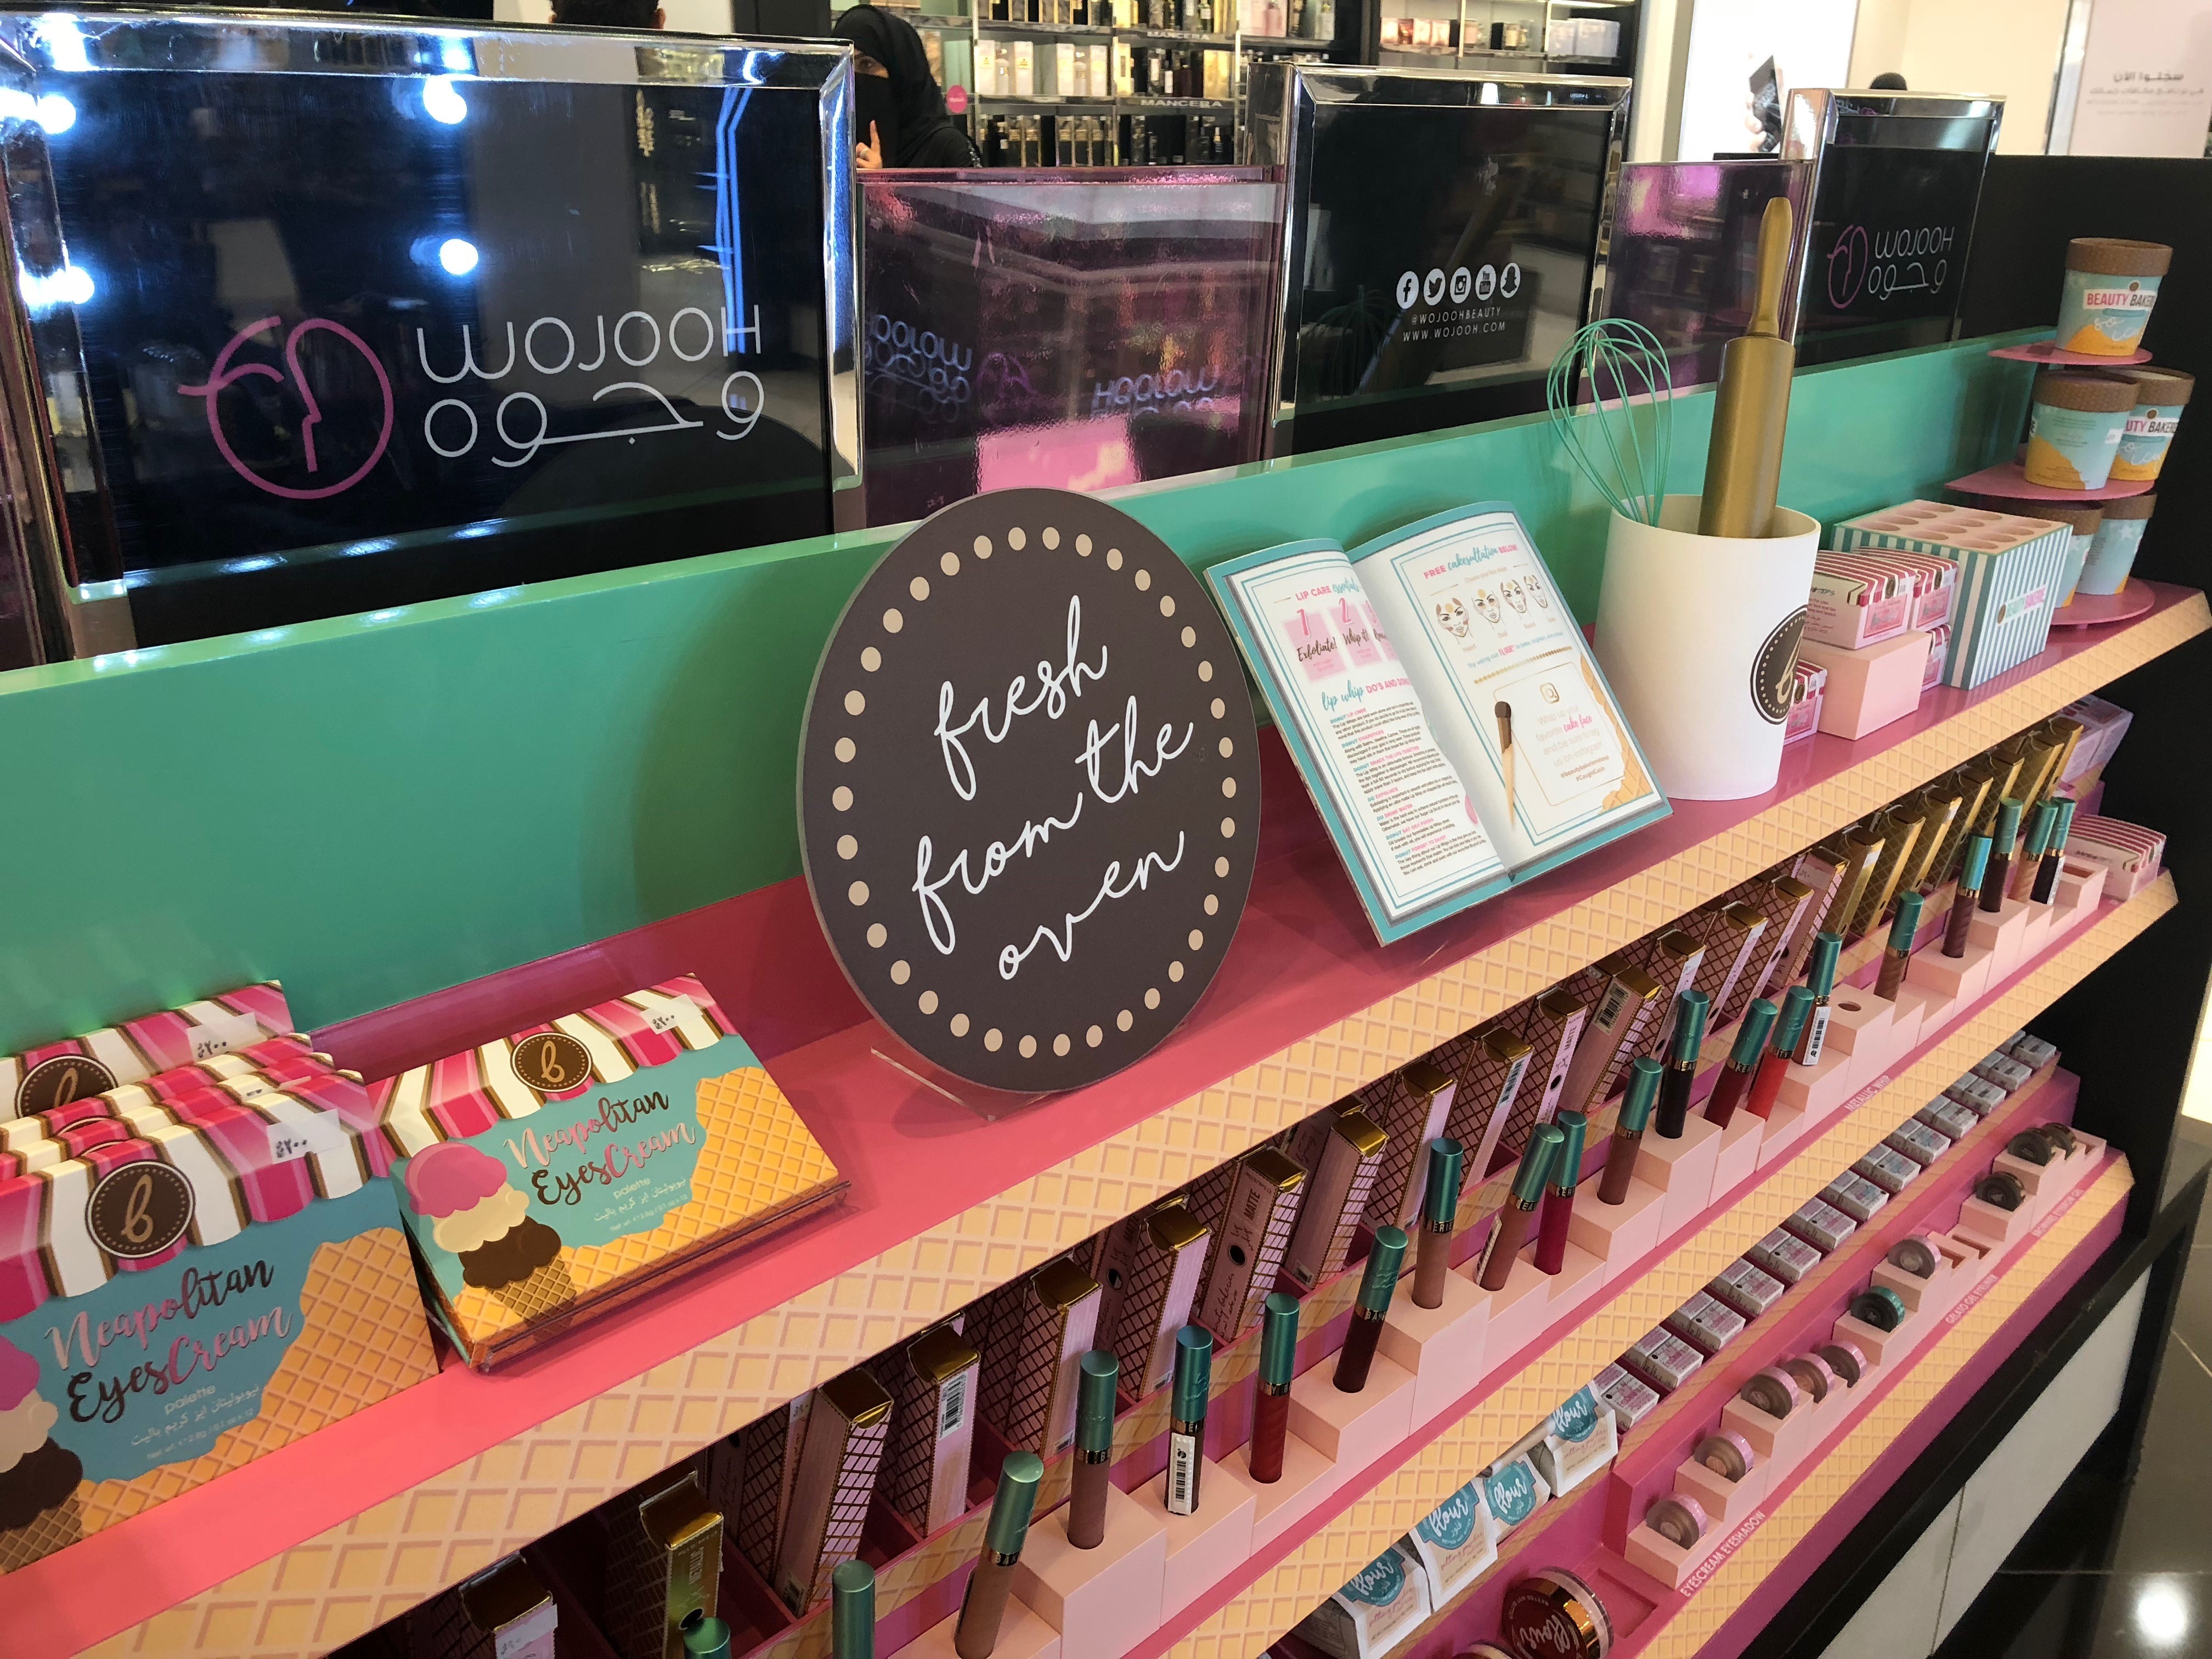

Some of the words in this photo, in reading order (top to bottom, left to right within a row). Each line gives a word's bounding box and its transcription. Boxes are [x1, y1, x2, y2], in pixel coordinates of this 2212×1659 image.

[1141, 99, 1223, 109] MANCERA
[1875, 227, 1955, 259] WOJOOH
[1411, 306, 1501, 325] @WOJOOHBEAUTY
[2086, 293, 2129, 306] BEAUTY
[416, 304, 761, 383] WOJOOH
[1403, 321, 1506, 342] WWW.WOJOOH.COM
[1423, 565, 1447, 579] FREE
[1447, 545, 1499, 571] cakesultation
[1498, 544, 1519, 554] BELOW!
[1295, 590, 1310, 601] LIP
[1311, 585, 1332, 597] CARE
[1296, 608, 1311, 637] 1
[1338, 597, 1353, 624] 2
[1296, 636, 1338, 662] Exfoliate!
[1342, 628, 1362, 647] Whip
[1477, 656, 1491, 665] using
[934, 595, 1108, 800] fresh
[1322, 691, 1339, 712] lip
[1341, 679, 1364, 703] whip
[1365, 682, 1384, 694] DO'S
[1384, 679, 1397, 689] AND
[1564, 716, 1579, 732] cake
[1578, 713, 1593, 729] face
[912, 792, 1084, 955] from
[1075, 696, 1194, 803] the
[998, 831, 1185, 980] oven
[1564, 1024, 1577, 1051] MATTE
[1844, 1087, 1878, 1113] METALLIC
[1871, 1075, 1892, 1089] WHIP
[503, 1090, 670, 1169] Neapolitan
[530, 1121, 697, 1206] EyesCream
[613, 1178, 651, 1200] palette
[1244, 1188, 1260, 1221] MATTE
[44, 1260, 275, 1370] Neapolitan
[67, 1306, 294, 1424] EyesCream
[165, 1385, 216, 1415] palette
[1553, 1400, 1588, 1432] flour
[1494, 1477, 1528, 1515] flour
[1429, 1497, 1469, 1537] flour
[1680, 1551, 1726, 1597] EYESCREAM
[1720, 1510, 1766, 1554] EYESHADOW
